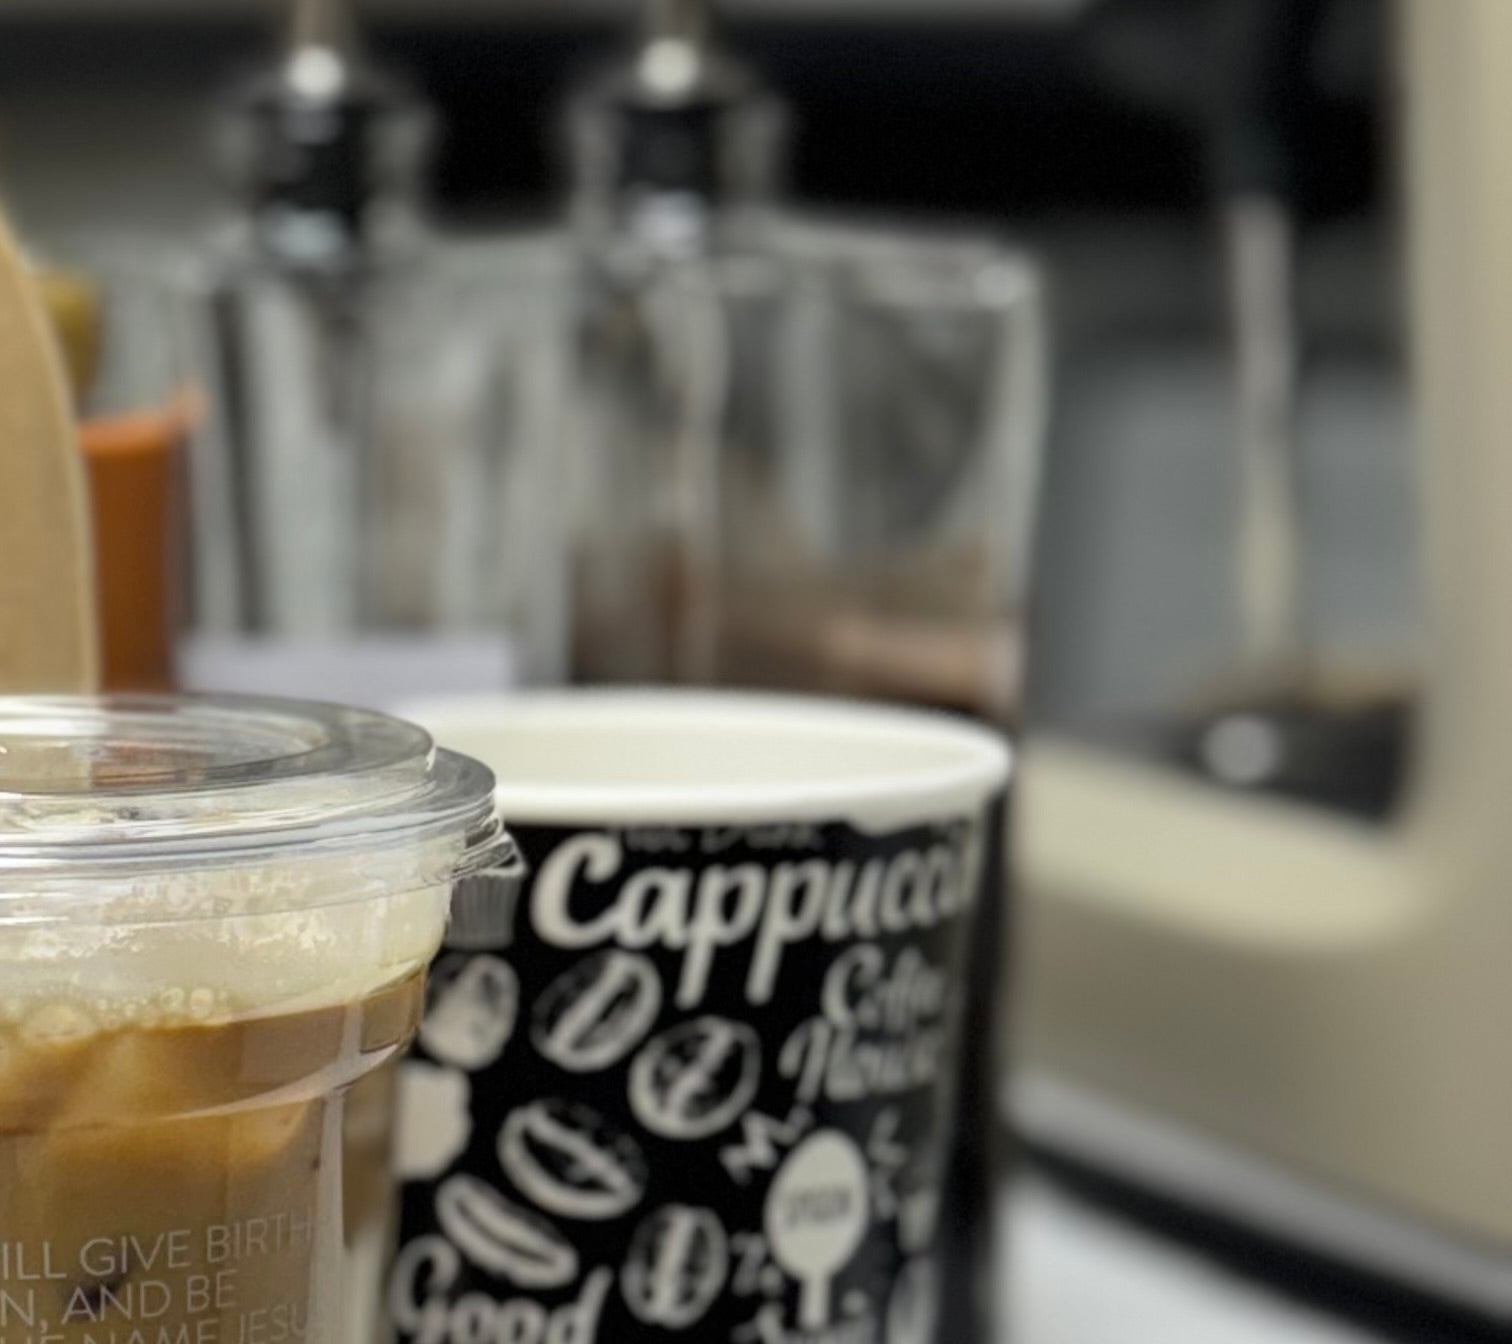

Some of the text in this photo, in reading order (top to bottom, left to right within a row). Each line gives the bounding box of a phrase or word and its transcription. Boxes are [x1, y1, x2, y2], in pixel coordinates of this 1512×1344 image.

[78, 1229, 192, 1278] GIVE
[206, 1208, 313, 1264] BIRTH
[60, 1279, 172, 1326] AND
[186, 1268, 239, 1314] BE
